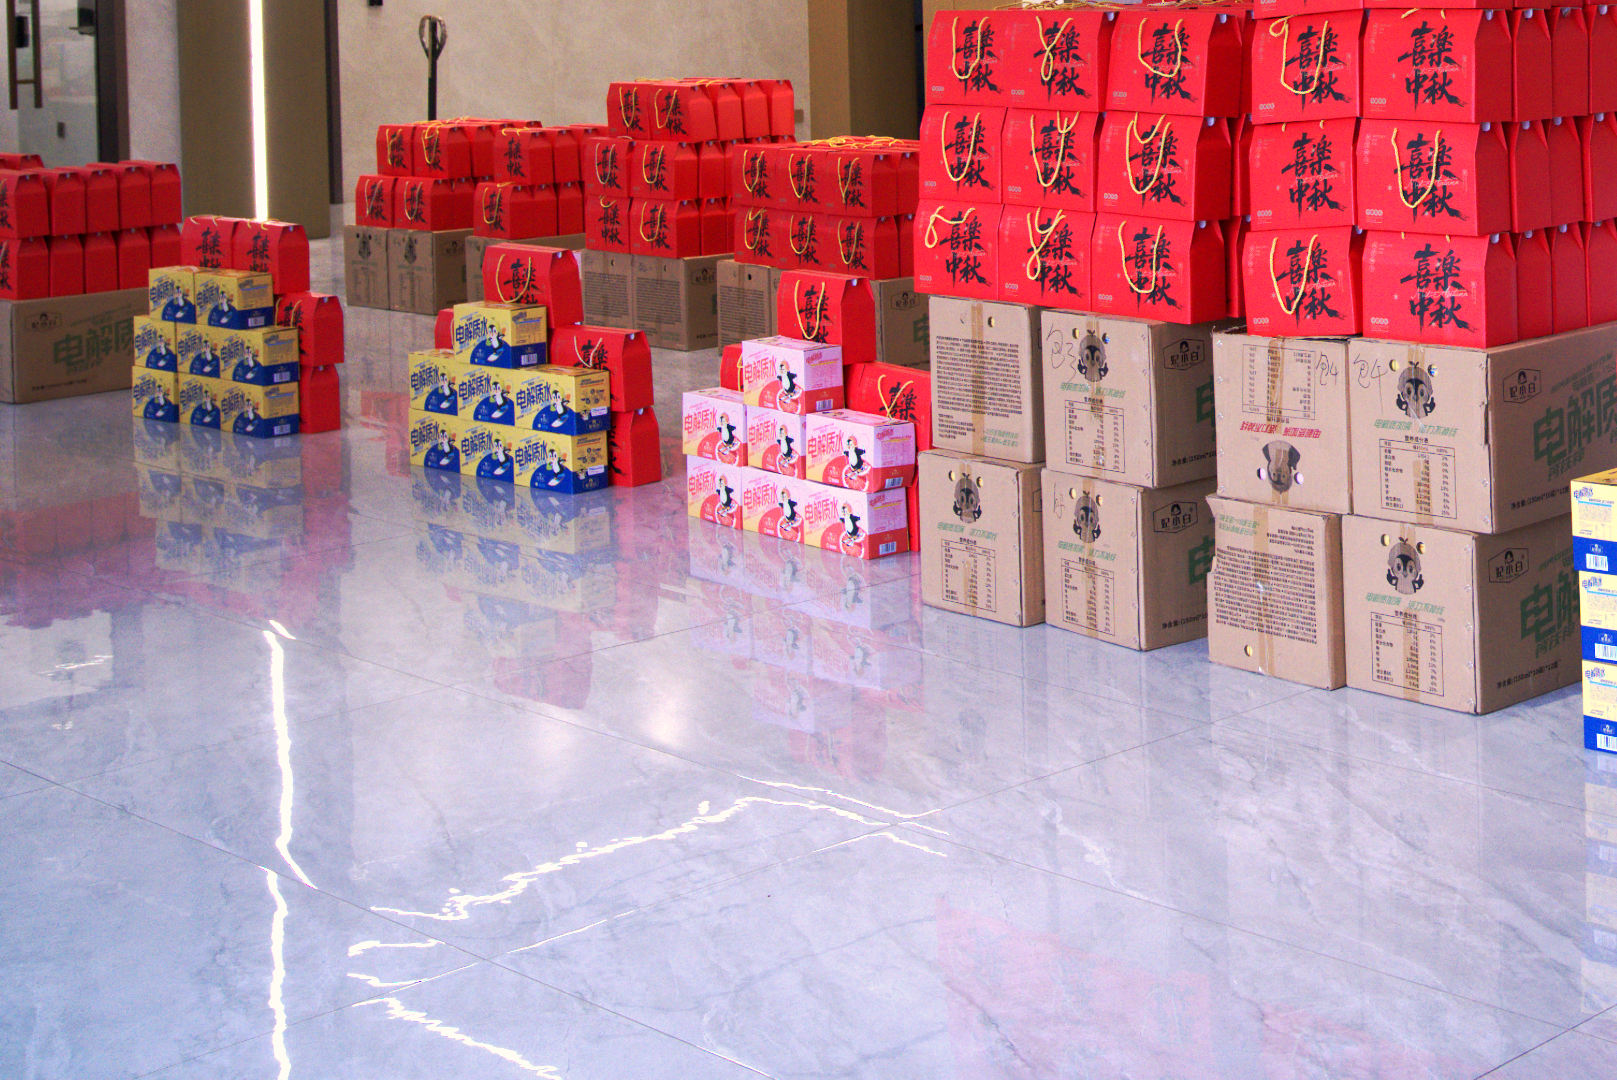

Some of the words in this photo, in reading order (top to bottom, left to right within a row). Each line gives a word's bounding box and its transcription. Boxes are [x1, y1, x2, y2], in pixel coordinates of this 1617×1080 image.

[959, 64, 1003, 99] 中秋
[1145, 70, 1197, 105] 中秋
[1293, 70, 1351, 113] 中秋
[1405, 69, 1465, 113] 中秋
[949, 161, 995, 191] 中秋
[1289, 178, 1346, 221] 中秋
[1402, 181, 1468, 223] 中秋
[945, 254, 991, 288] 中秋
[1286, 288, 1346, 328] 中秋
[1409, 293, 1477, 334] 中秋
[455, 316, 488, 345] 电解质水
[411, 367, 440, 391] 电解质水
[744, 356, 777, 384] 电解质水
[459, 372, 491, 401] 电解质水
[516, 380, 552, 409] 电解质水
[411, 421, 440, 445] 电解质水
[685, 407, 717, 435] 电解质水
[748, 419, 777, 446] 电解质水
[461, 430, 493, 457] 电解质水
[515, 439, 548, 467] 电解质水
[807, 428, 844, 456] 电解质水
[689, 470, 717, 495] 电解质水
[743, 482, 777, 509] 电解质水
[805, 497, 838, 524] 电解质水
